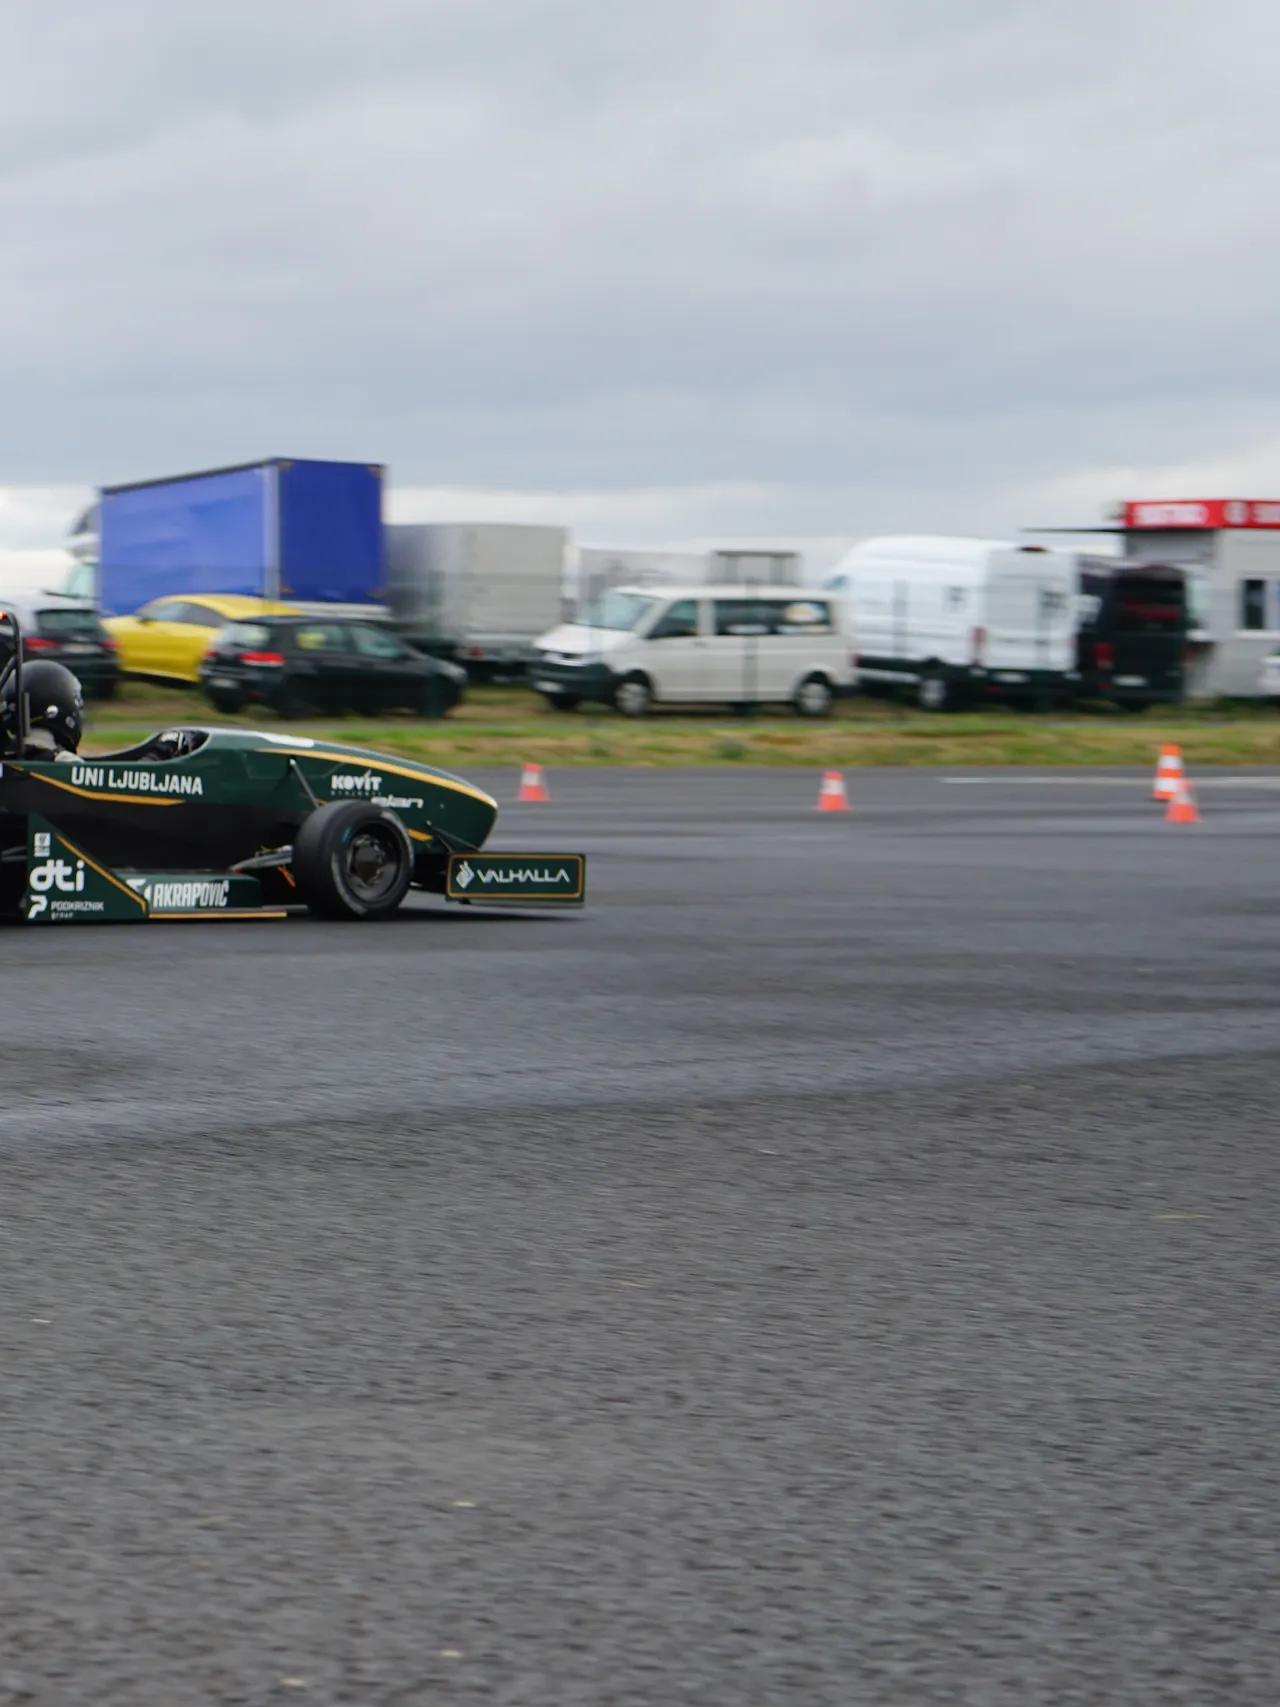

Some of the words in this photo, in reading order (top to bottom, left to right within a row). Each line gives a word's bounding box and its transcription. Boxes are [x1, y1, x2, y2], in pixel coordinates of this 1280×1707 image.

[71, 766, 104, 787] UNI
[108, 769, 204, 796] LJUBLJANA
[29, 859, 85, 891] dti
[476, 868, 570, 884] VALHALLA
